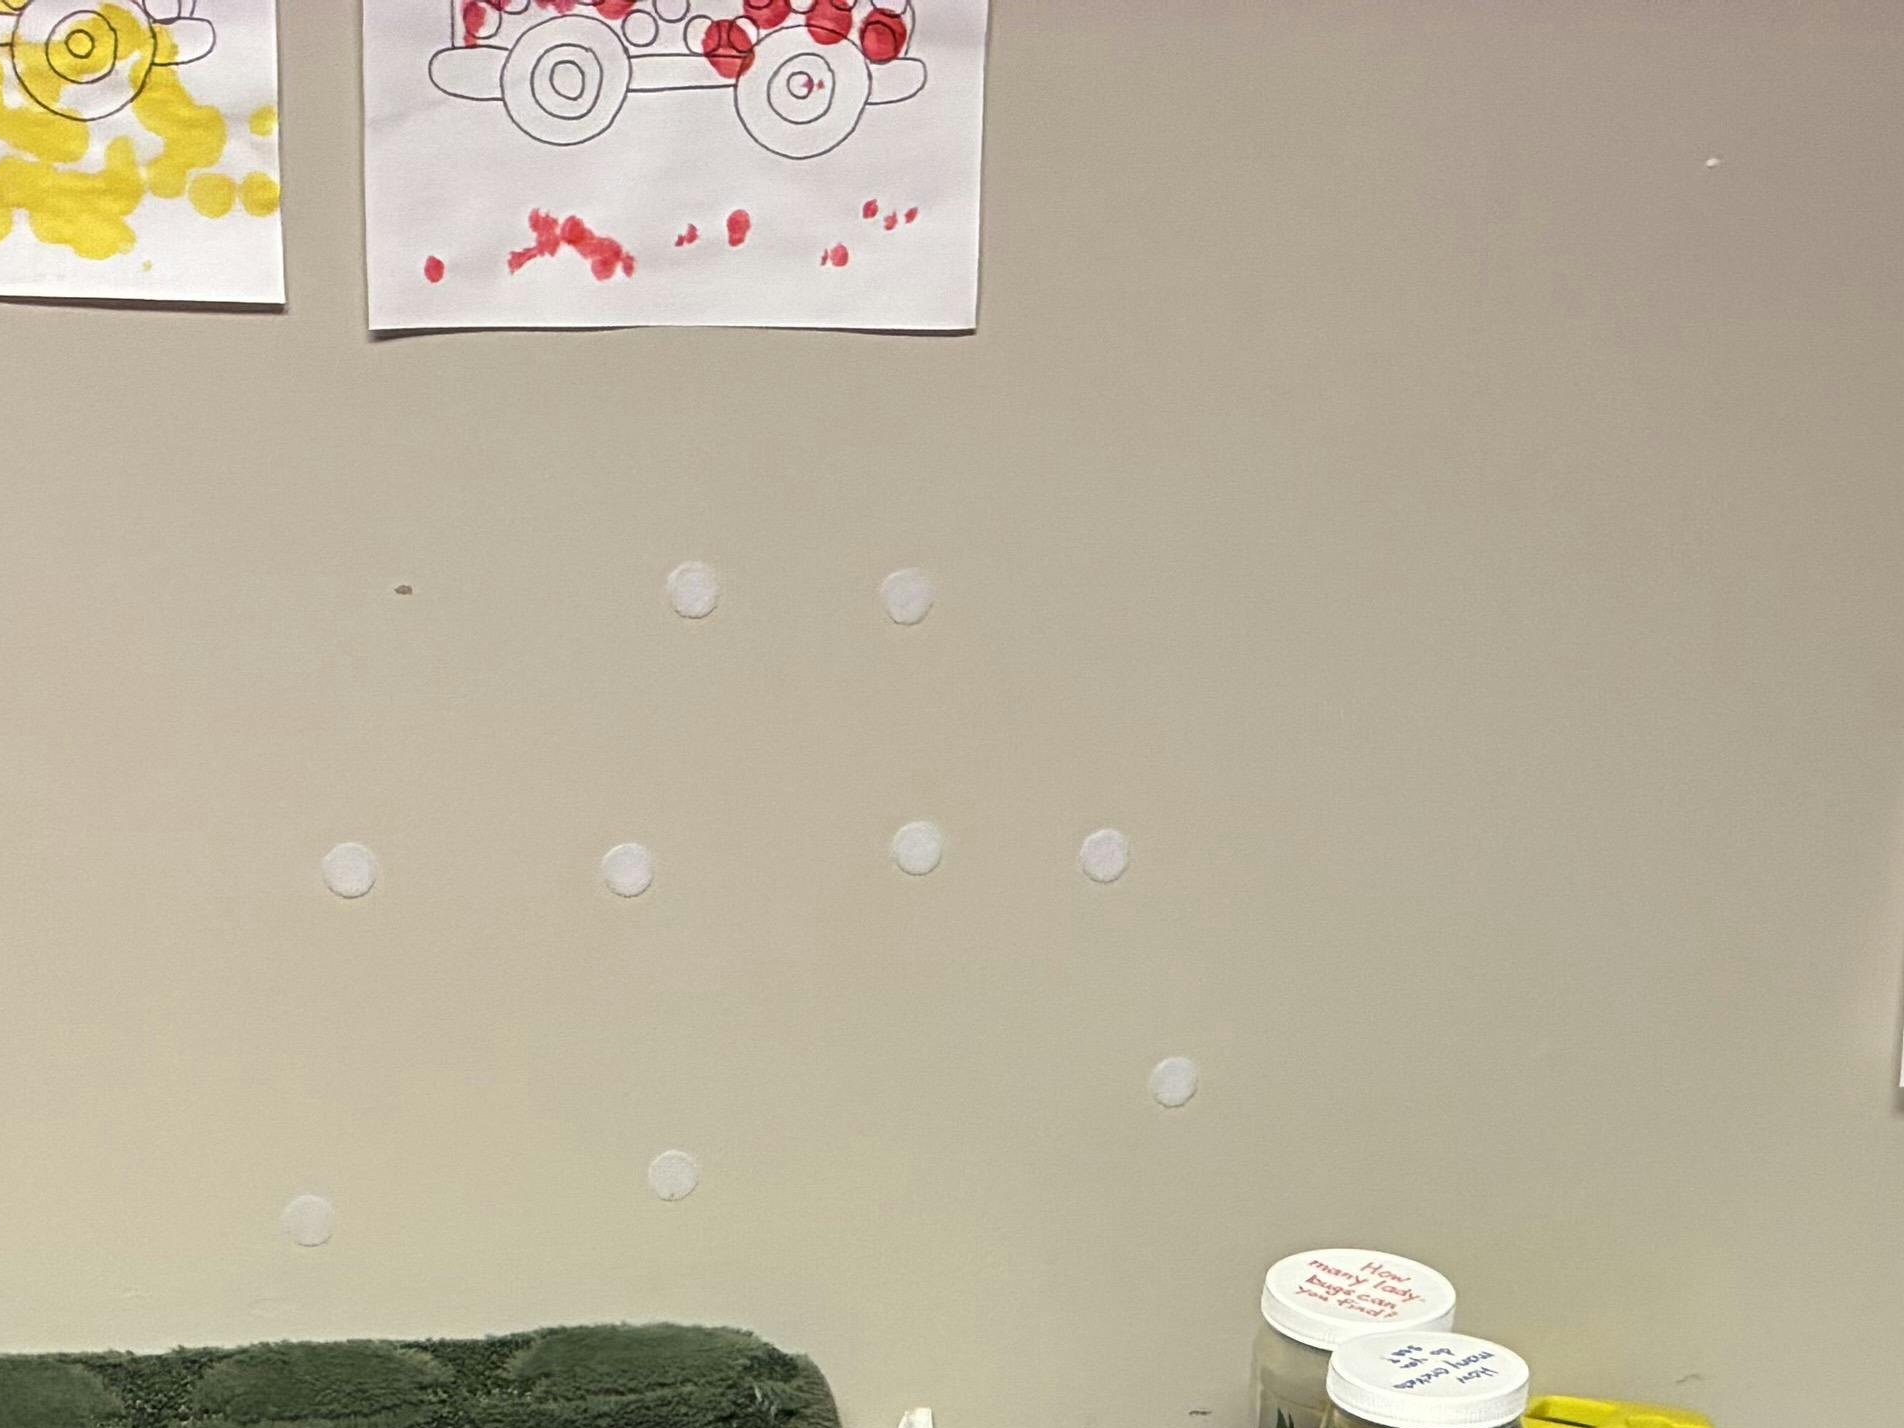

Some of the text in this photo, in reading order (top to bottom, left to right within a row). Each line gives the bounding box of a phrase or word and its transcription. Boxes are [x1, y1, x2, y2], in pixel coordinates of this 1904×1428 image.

[1308, 1259, 1369, 1287] many
[1360, 1261, 1411, 1283] How
[1295, 1285, 1329, 1302] you
[1305, 1274, 1397, 1309] bugs can
